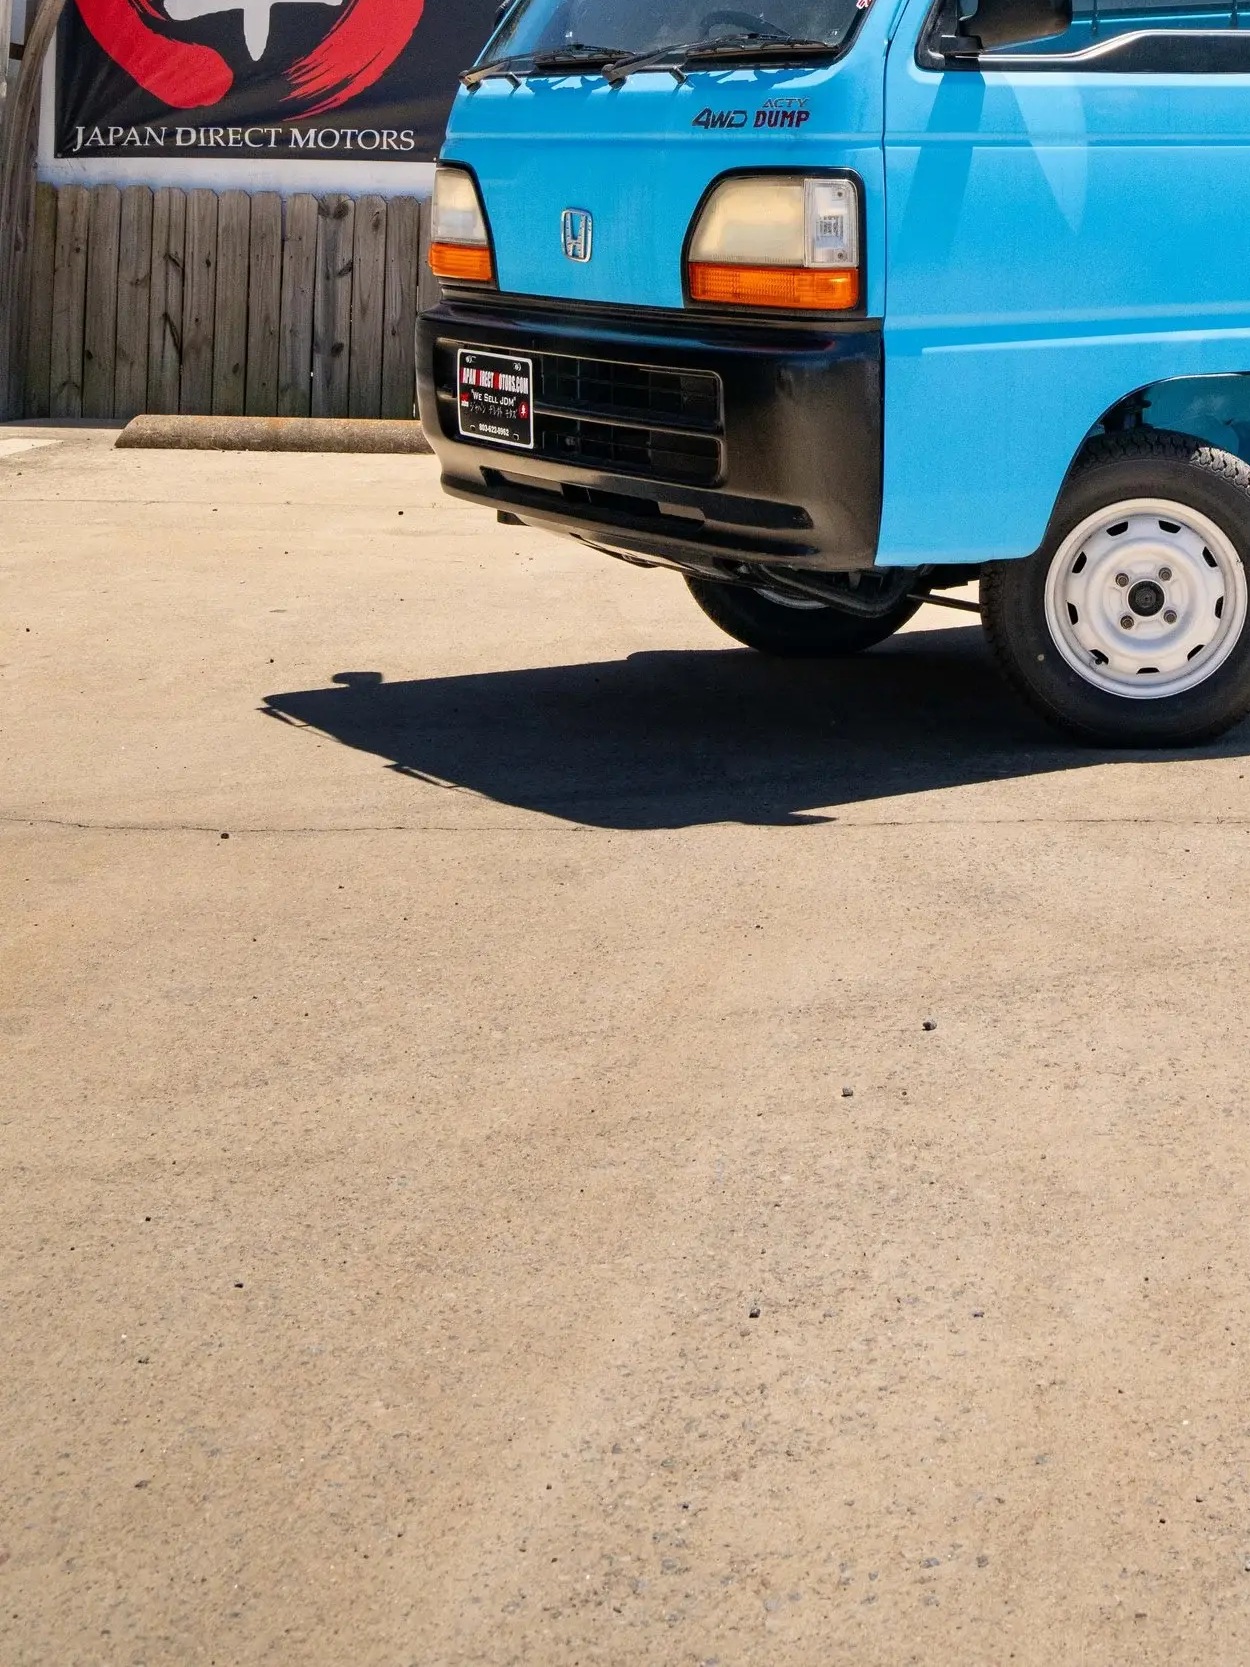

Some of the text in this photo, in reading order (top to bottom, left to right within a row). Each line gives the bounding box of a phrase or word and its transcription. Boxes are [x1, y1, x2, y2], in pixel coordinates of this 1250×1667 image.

[762, 97, 810, 108] ACTY
[692, 106, 811, 130] 4WD DUMP
[73, 126, 416, 152] JAPAN DIRECT MOTORS
